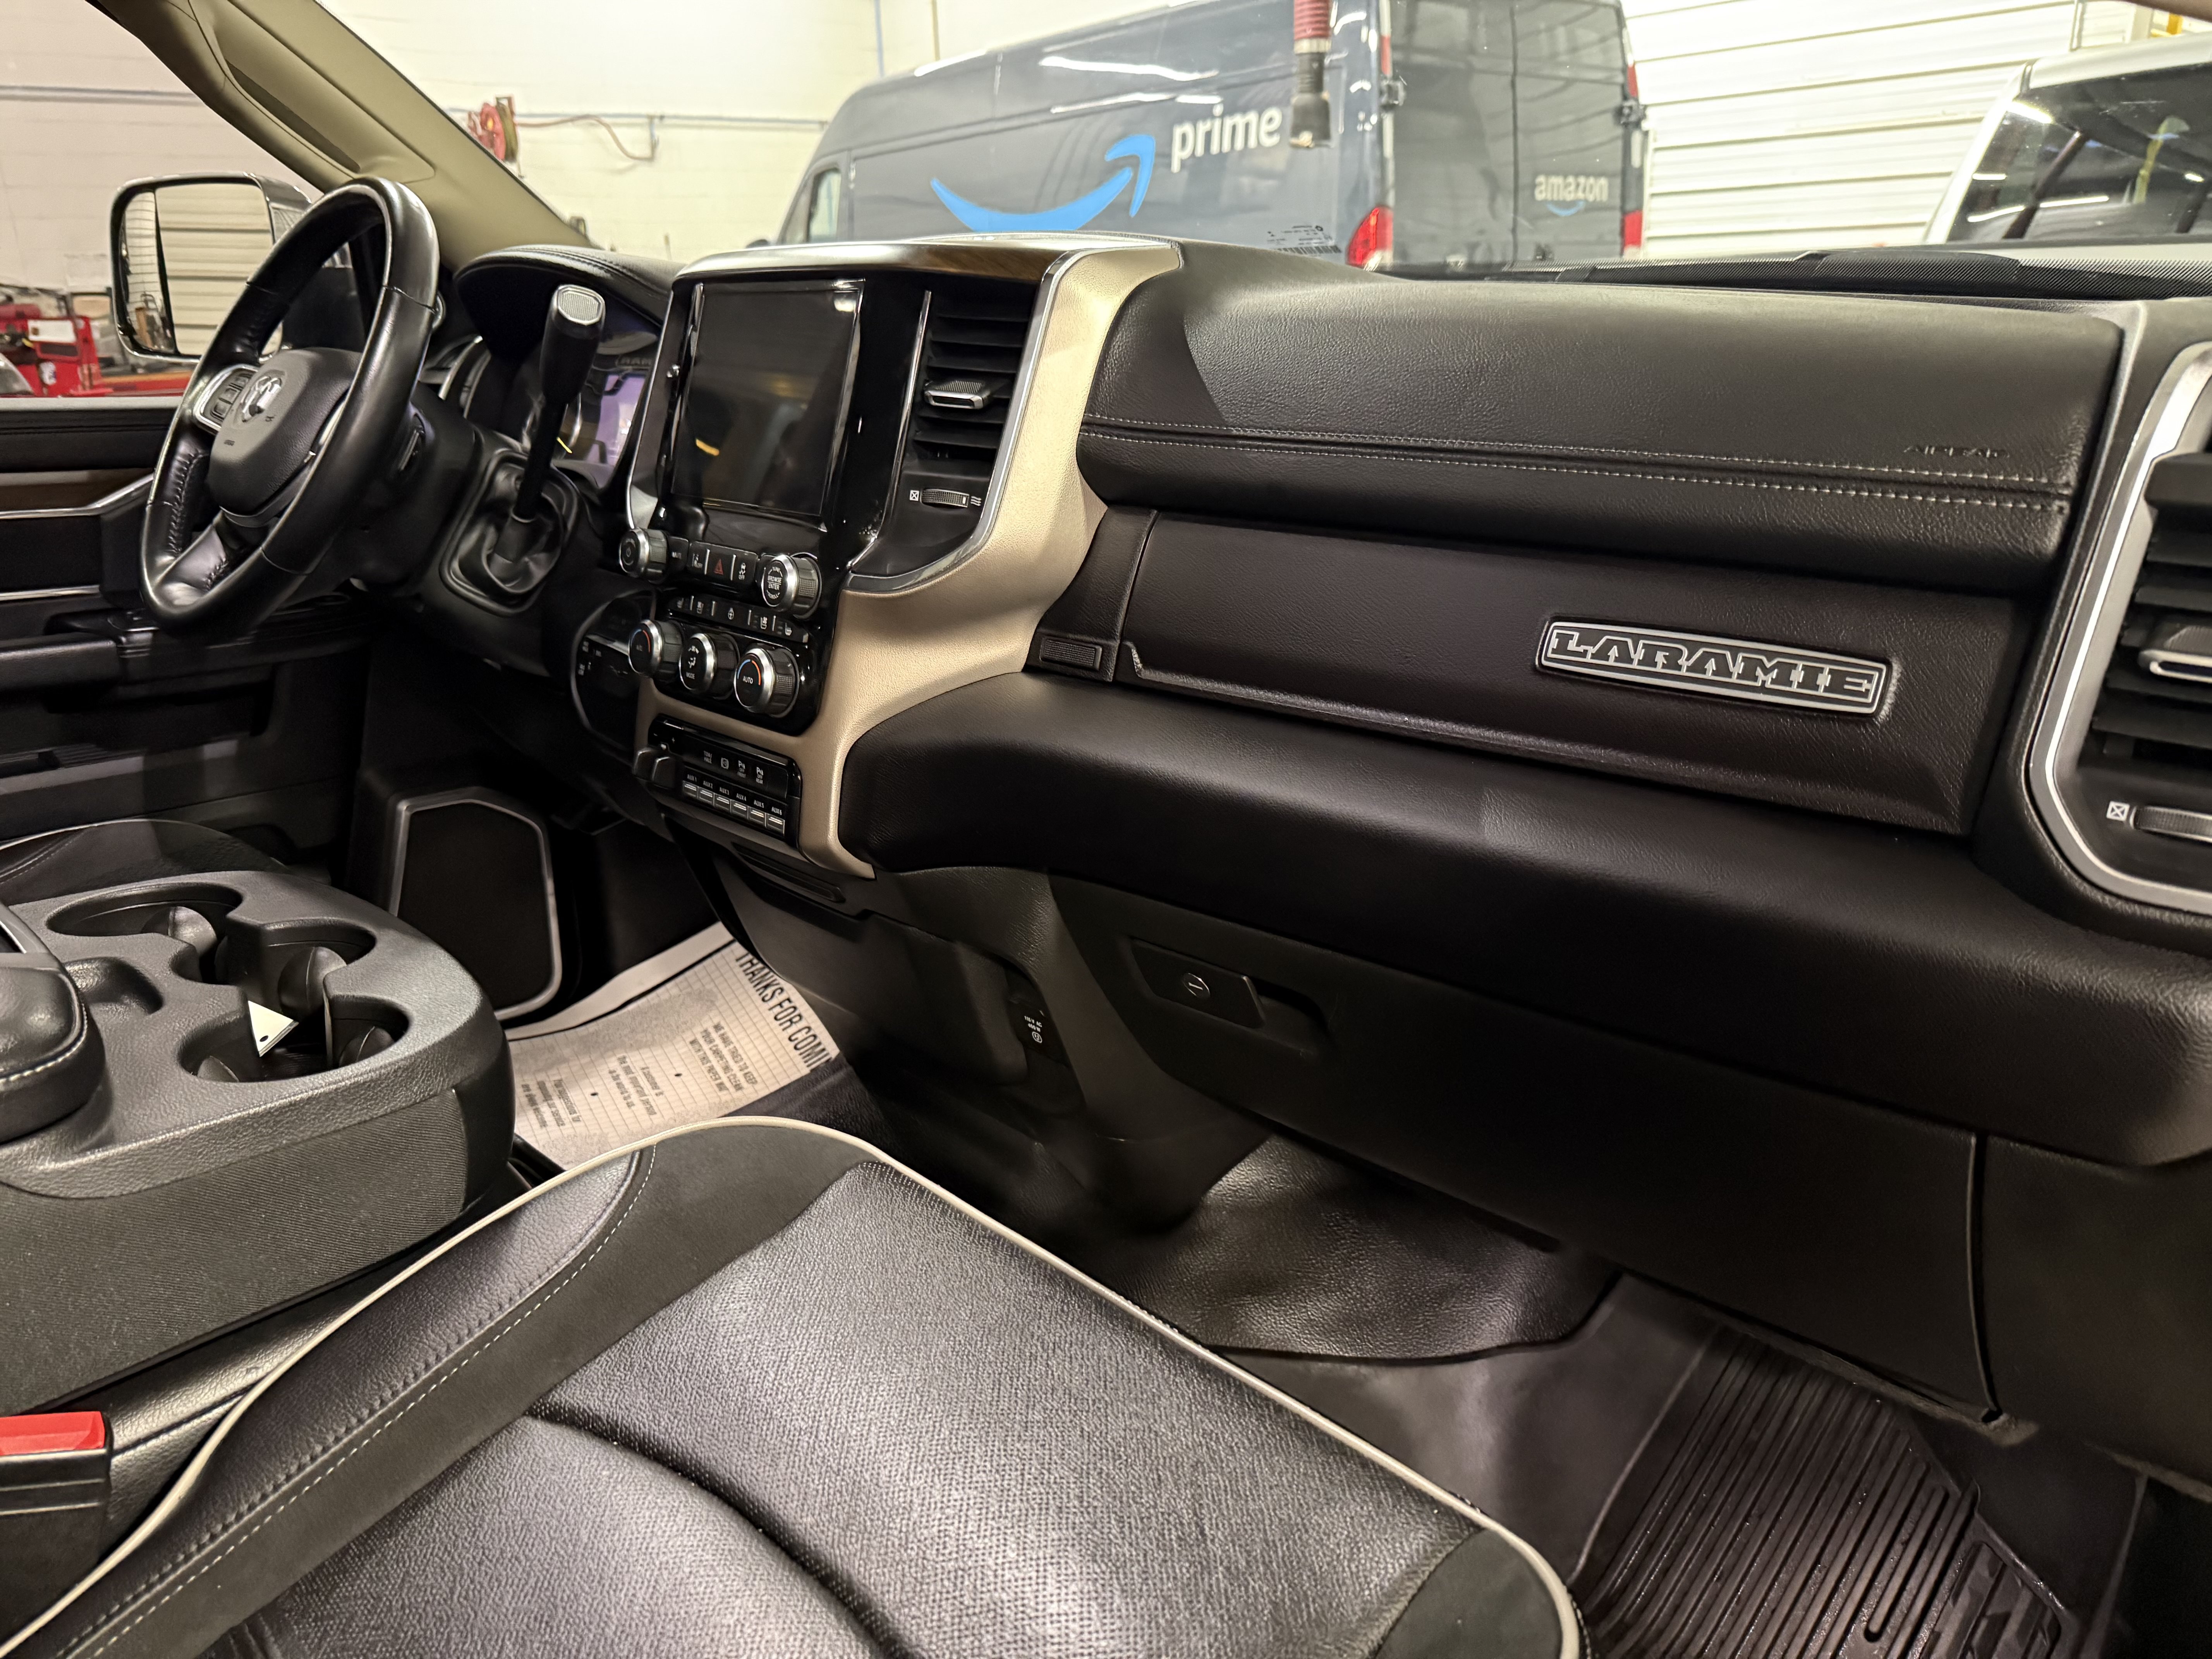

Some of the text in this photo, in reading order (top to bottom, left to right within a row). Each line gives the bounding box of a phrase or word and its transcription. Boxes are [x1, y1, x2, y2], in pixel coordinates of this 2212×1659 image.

[1171, 103, 1283, 173] prime
[1534, 174, 1609, 202] amazon
[768, 575, 782, 584] BROWSE
[1548, 629, 1879, 703] LARAMIE
[743, 676, 753, 684] AUTO
[735, 951, 833, 1072] THANKS FOR COMI
[689, 1037, 704, 1054] WITH
[697, 1051, 712, 1066] THIS
[705, 1063, 722, 1082] PAPER
[699, 1028, 716, 1046] YOUR
[727, 1072, 745, 1092] CLEAN
[727, 1045, 744, 1064] TRIED
[738, 1061, 749, 1072] TO
[742, 1070, 758, 1085] KEEP
[639, 1097, 657, 1116] person
